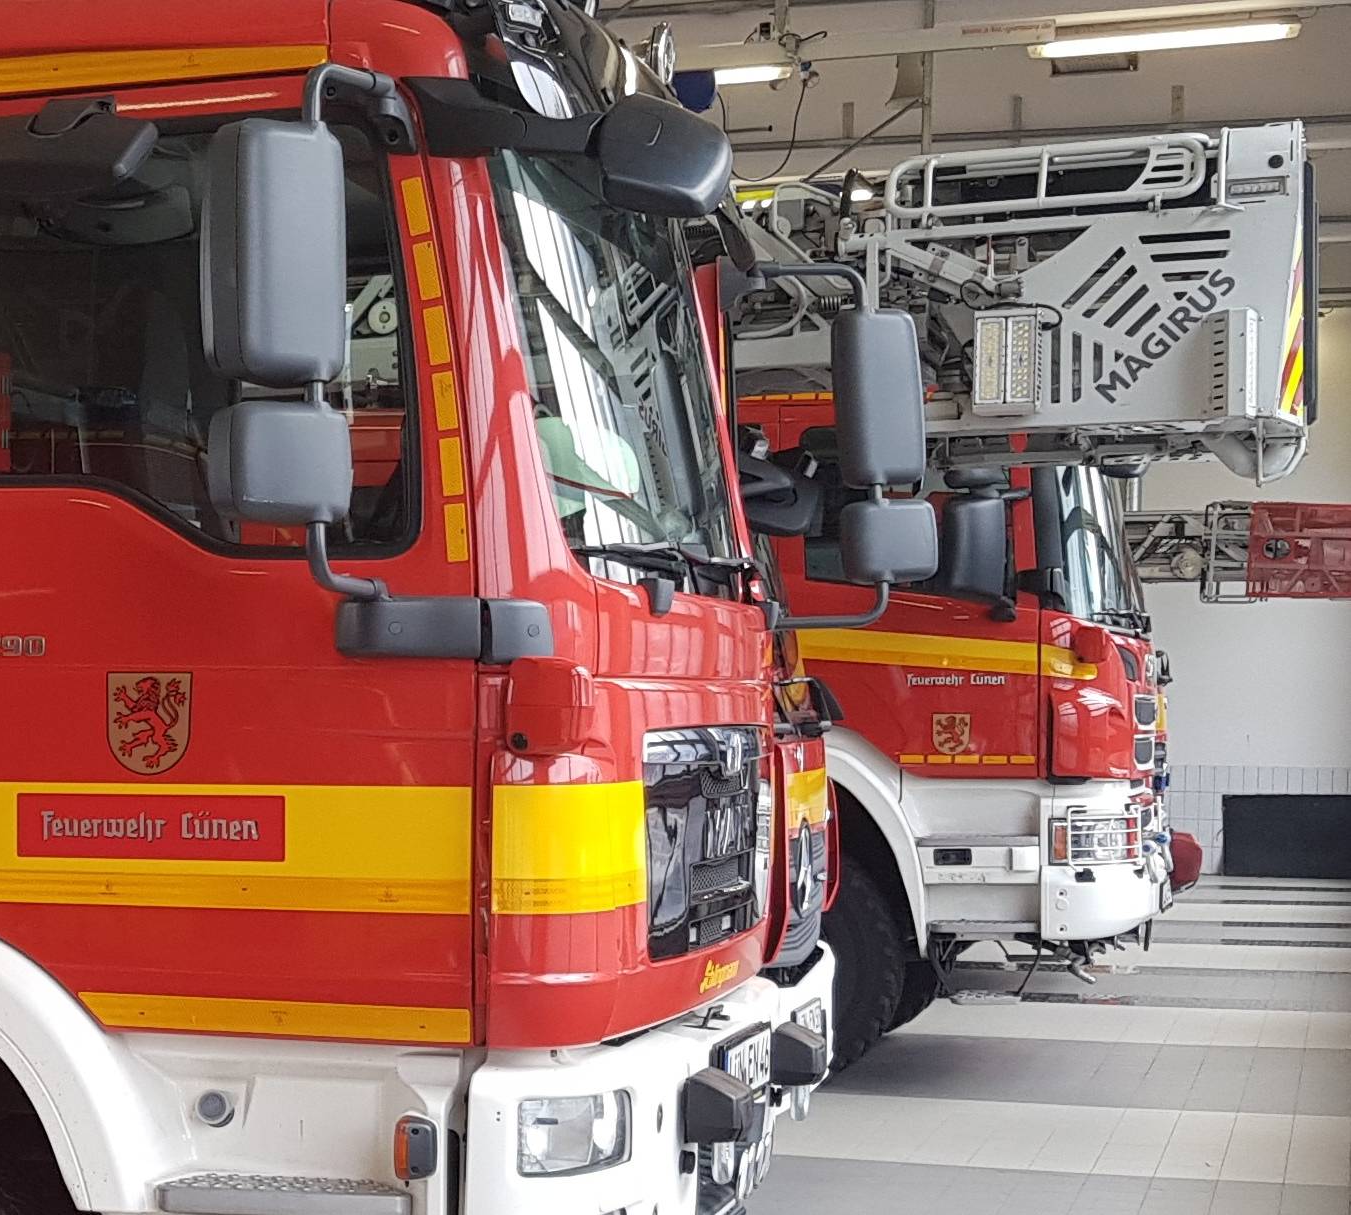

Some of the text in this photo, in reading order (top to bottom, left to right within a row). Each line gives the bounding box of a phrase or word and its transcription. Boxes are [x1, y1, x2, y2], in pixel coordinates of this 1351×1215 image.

[1095, 268, 1235, 404] MAGIRUS
[906, 673, 964, 687] Feuerwehr
[41, 810, 259, 842] Feuerwehr Lünen
